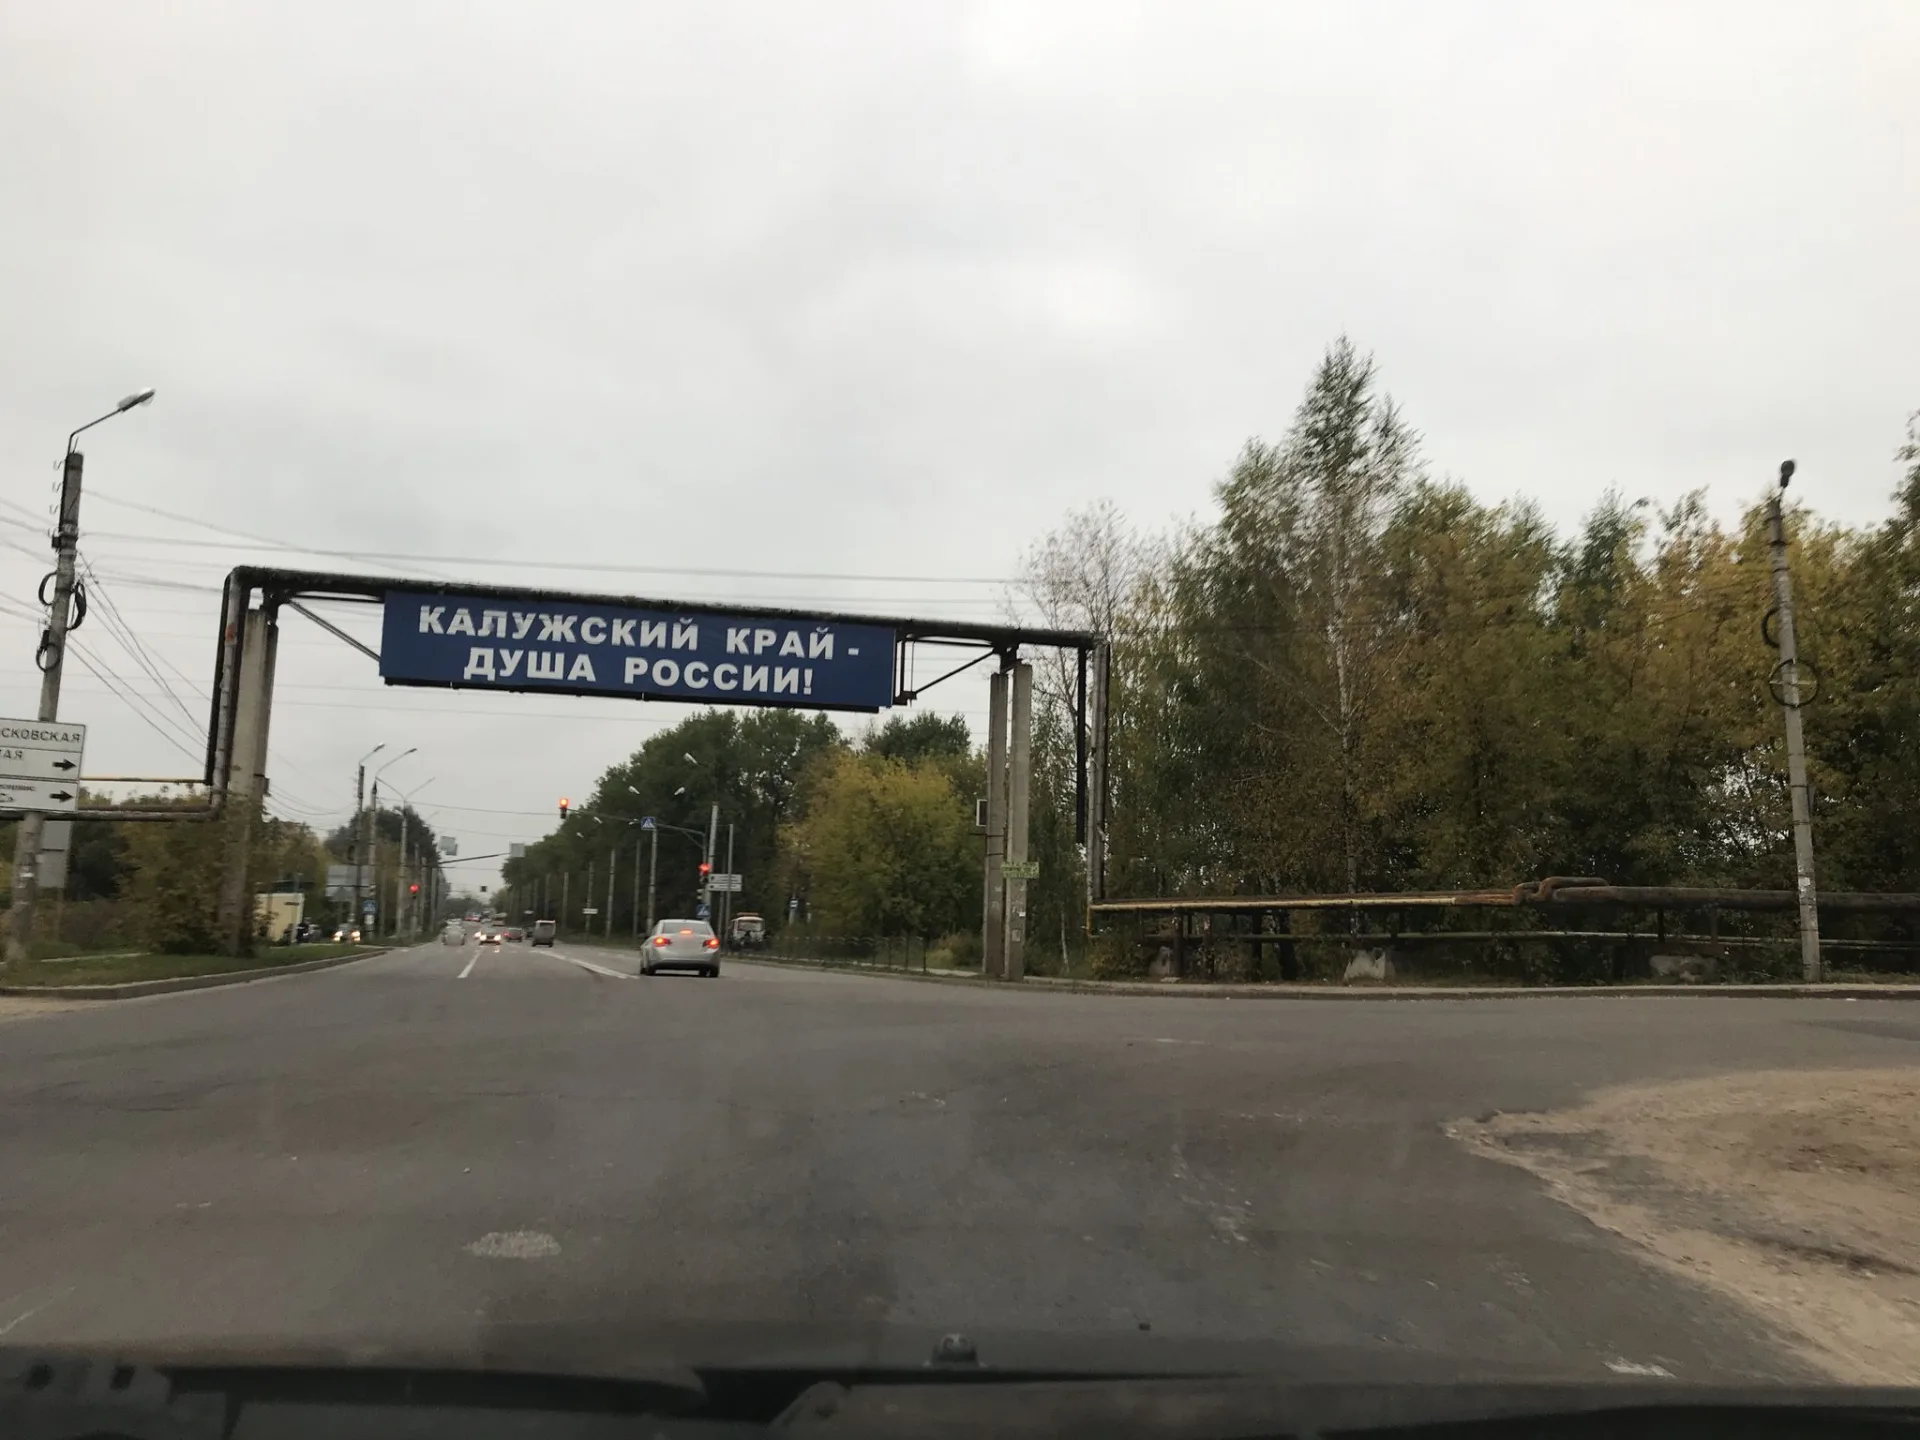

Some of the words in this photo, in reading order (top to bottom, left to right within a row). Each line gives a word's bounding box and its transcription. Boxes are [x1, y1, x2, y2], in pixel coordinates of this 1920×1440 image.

[418, 604, 698, 651] КАЛУЖСКИЙ
[726, 626, 835, 660] КРАЙ
[463, 646, 597, 682] ДУША
[623, 656, 814, 695] РОССИИ!
[0, 727, 81, 743] СКОВСКАЯ
[0, 748, 24, 761] АЯ
